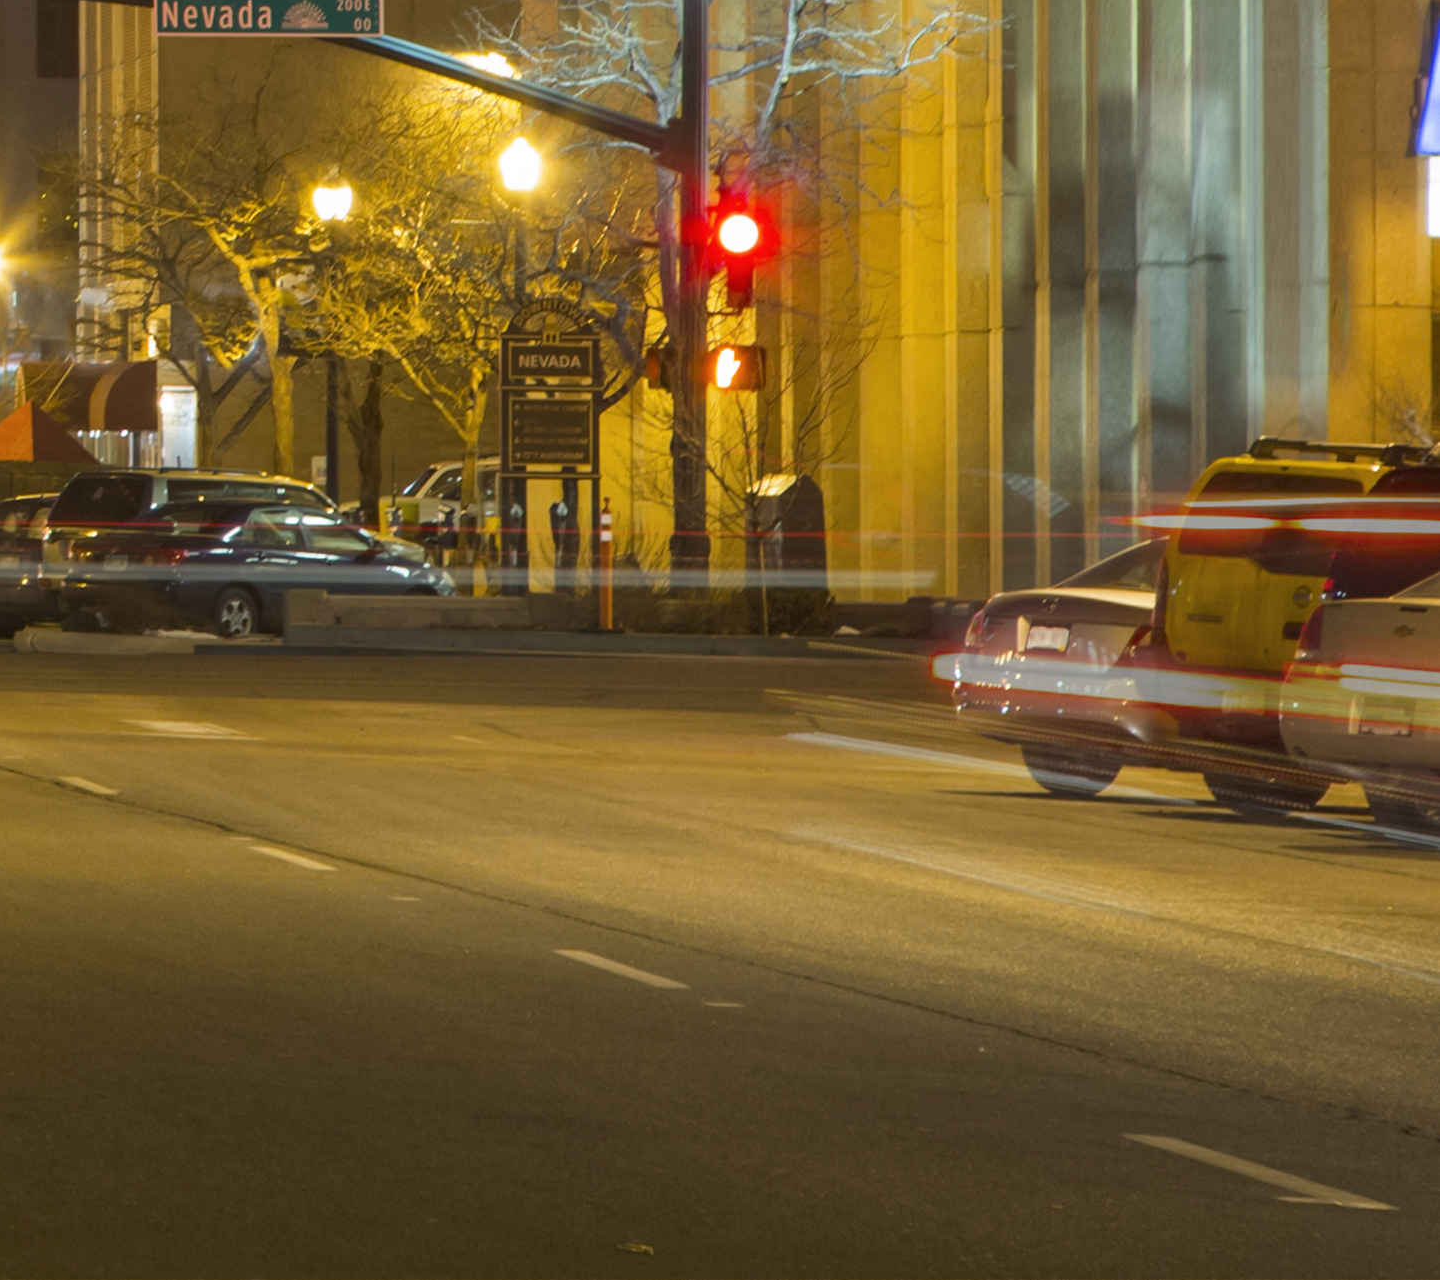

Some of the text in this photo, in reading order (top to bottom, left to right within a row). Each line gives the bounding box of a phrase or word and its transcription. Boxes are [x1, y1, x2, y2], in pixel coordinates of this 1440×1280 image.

[161, 0, 272, 29] Nevada
[353, 17, 372, 31] 00
[513, 300, 587, 328] DOWNTOWN
[518, 354, 582, 369] NEVADA
